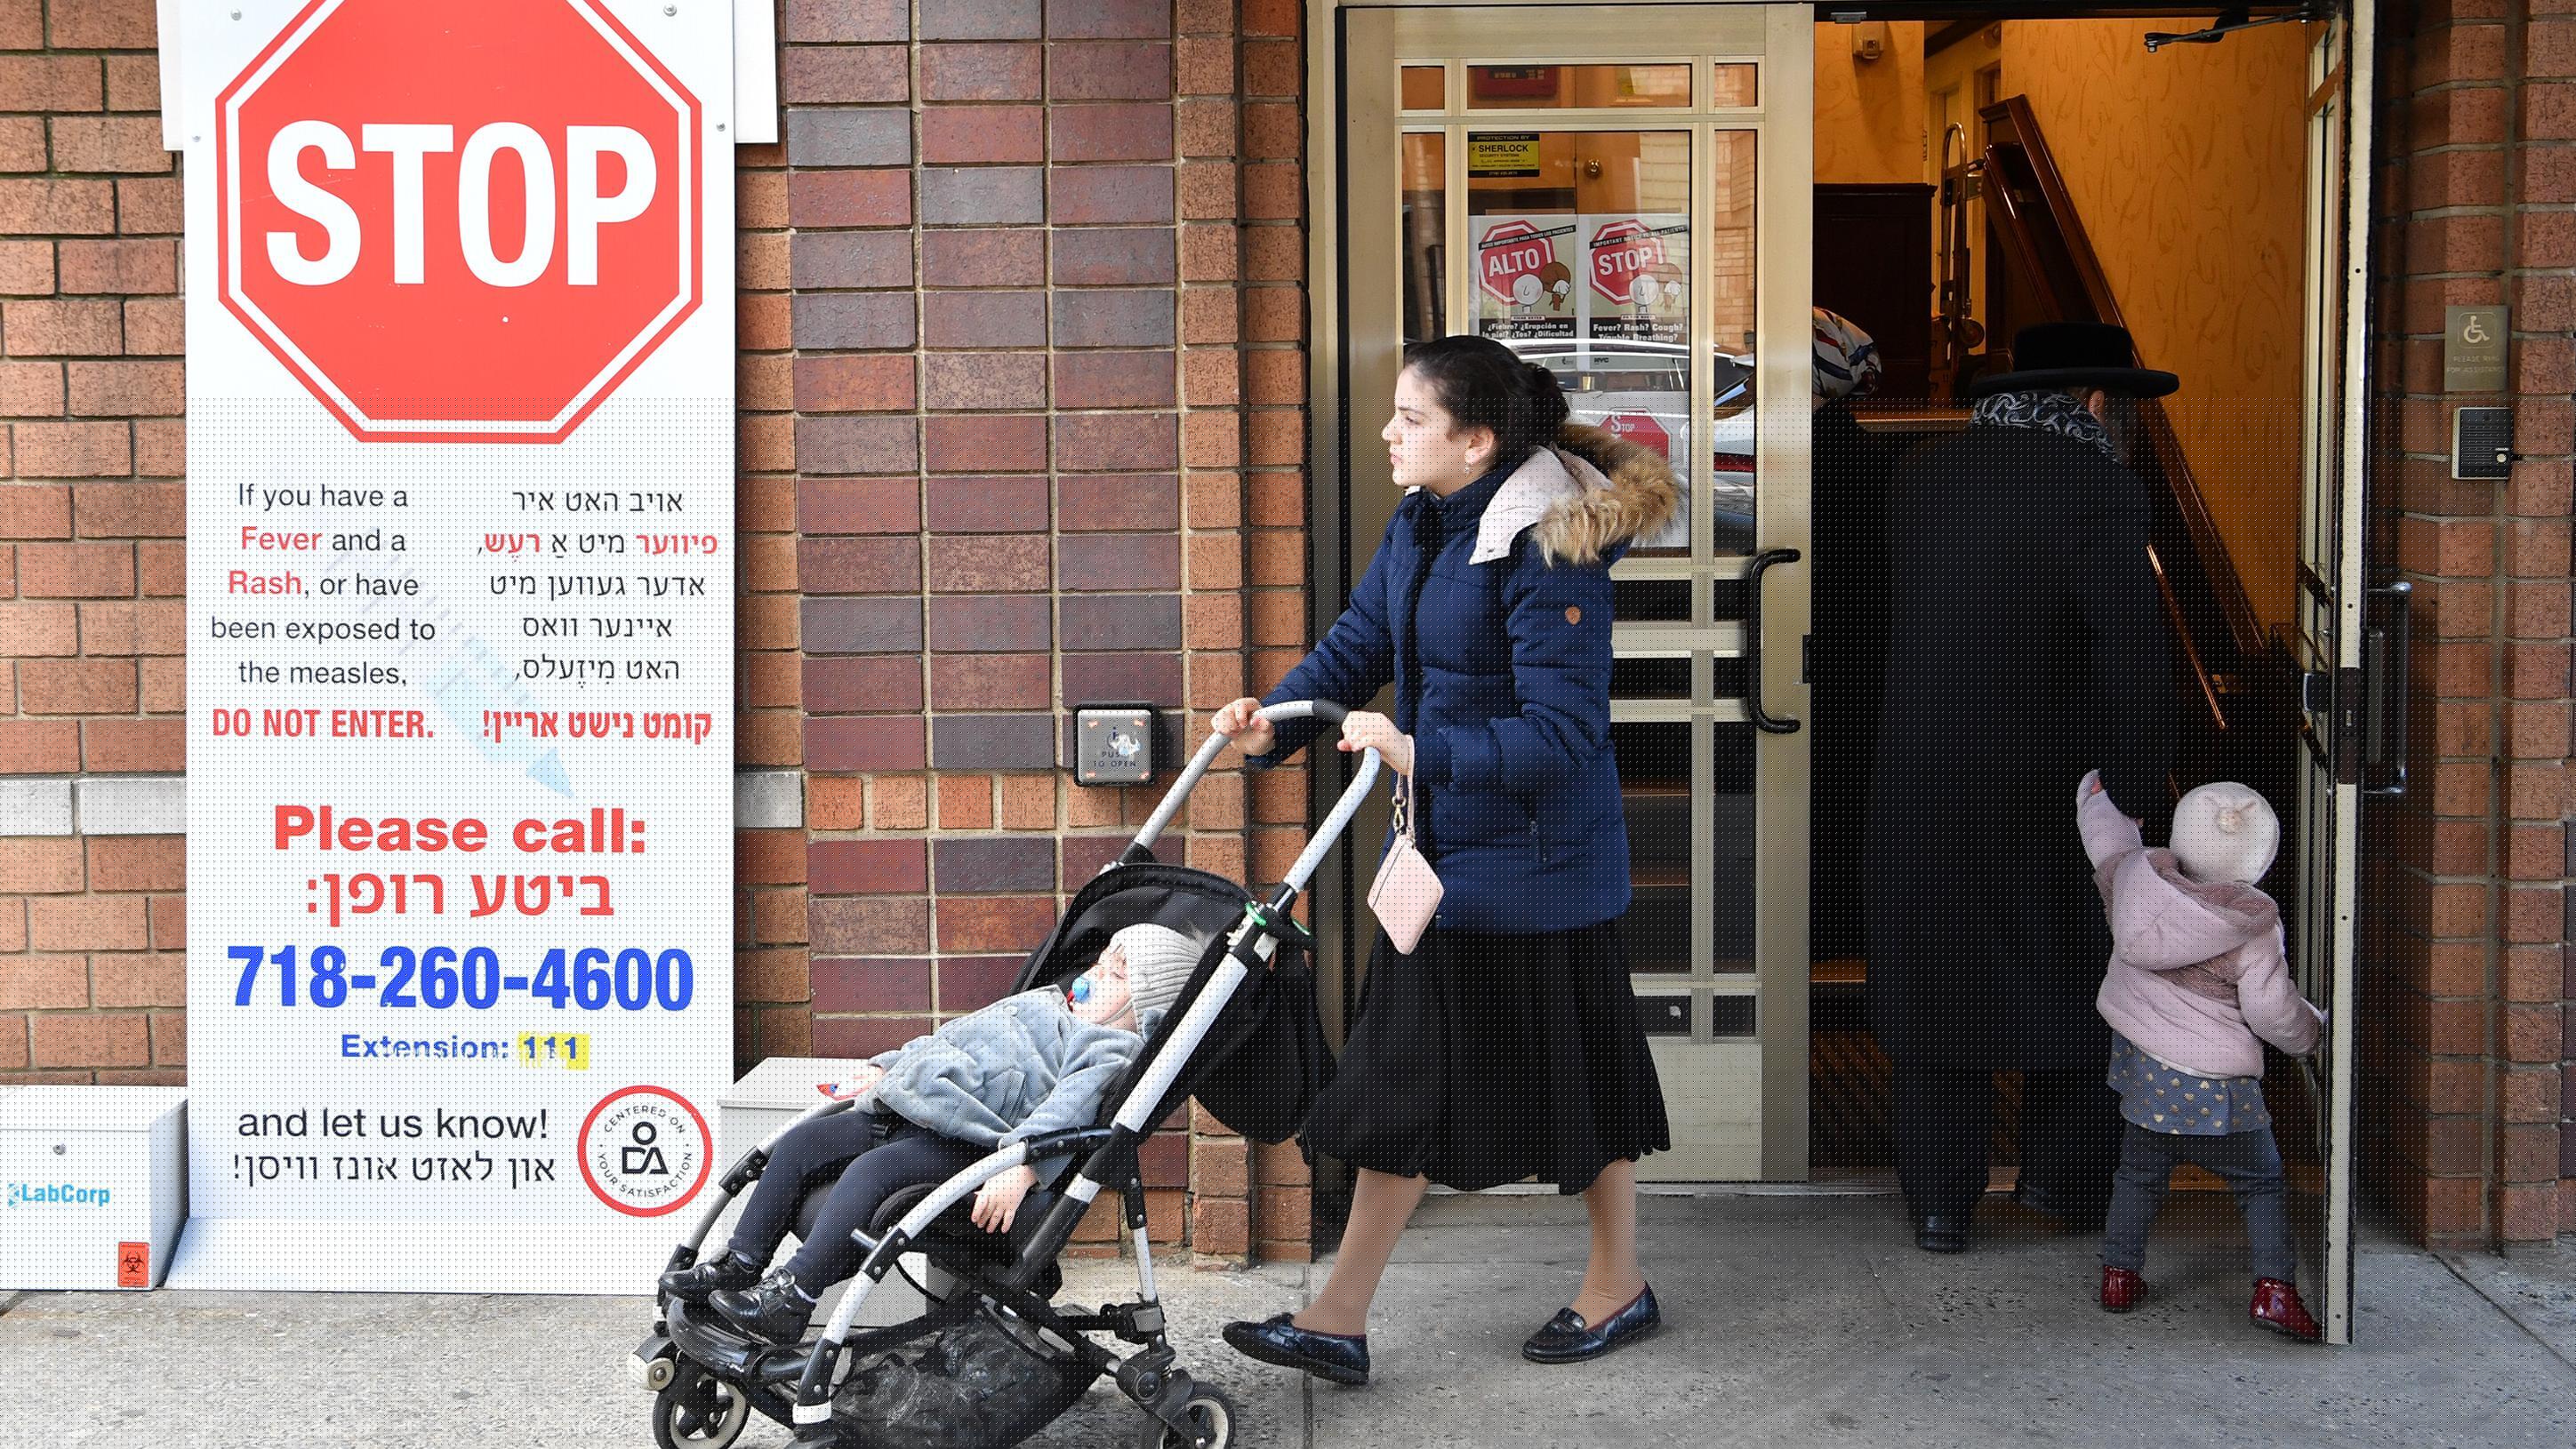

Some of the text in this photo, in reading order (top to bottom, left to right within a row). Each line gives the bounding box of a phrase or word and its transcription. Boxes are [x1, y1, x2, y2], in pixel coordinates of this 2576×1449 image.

[267, 120, 657, 287] STOP
[1593, 238, 1623, 247] IMPORTANT
[1489, 248, 1539, 276] ALTO
[1598, 246, 1652, 276] STOP
[1488, 323, 1518, 331] ¿Fiebre?
[1521, 322, 1557, 331] ¿Erupción
[1512, 331, 1531, 339] ¿Tos?
[1534, 330, 1574, 338] ¿Dificultad
[1593, 324, 1683, 332] Fever? Rash? Cough?
[1633, 333, 1679, 342] Breathing?
[239, 484, 407, 511] If you have a
[513, 492, 683, 511] אויב האט איר
[241, 526, 405, 551] Fever and a
[579, 534, 624, 553] מיט
[636, 535, 718, 555] פיווער
[229, 571, 418, 598] Rash, or have
[491, 573, 705, 600] אדער געווען מיט
[212, 616, 435, 644] been exposed to
[524, 618, 671, 637] איינער וואס
[239, 661, 406, 687] the measles,
[627, 660, 680, 679] האט
[213, 708, 434, 738] DO NOT ENTER.
[483, 710, 711, 744] קומט נישט אריין!
[1094, 760, 1136, 768] TO OPEN
[276, 805, 645, 853] Please call:
[307, 873, 614, 927] ביטע רופן:
[228, 945, 694, 1011] 718-260-4600
[342, 1034, 577, 1059] Extension: 111
[238, 1109, 547, 1138] and let us know!
[605, 1105, 686, 1133] CENTERED ON
[233, 1151, 556, 1189] און לאזט אונז וויסן!
[598, 1153, 692, 1197] YOUR SATISFACTION
[21, 1184, 111, 1207] LabCorp
